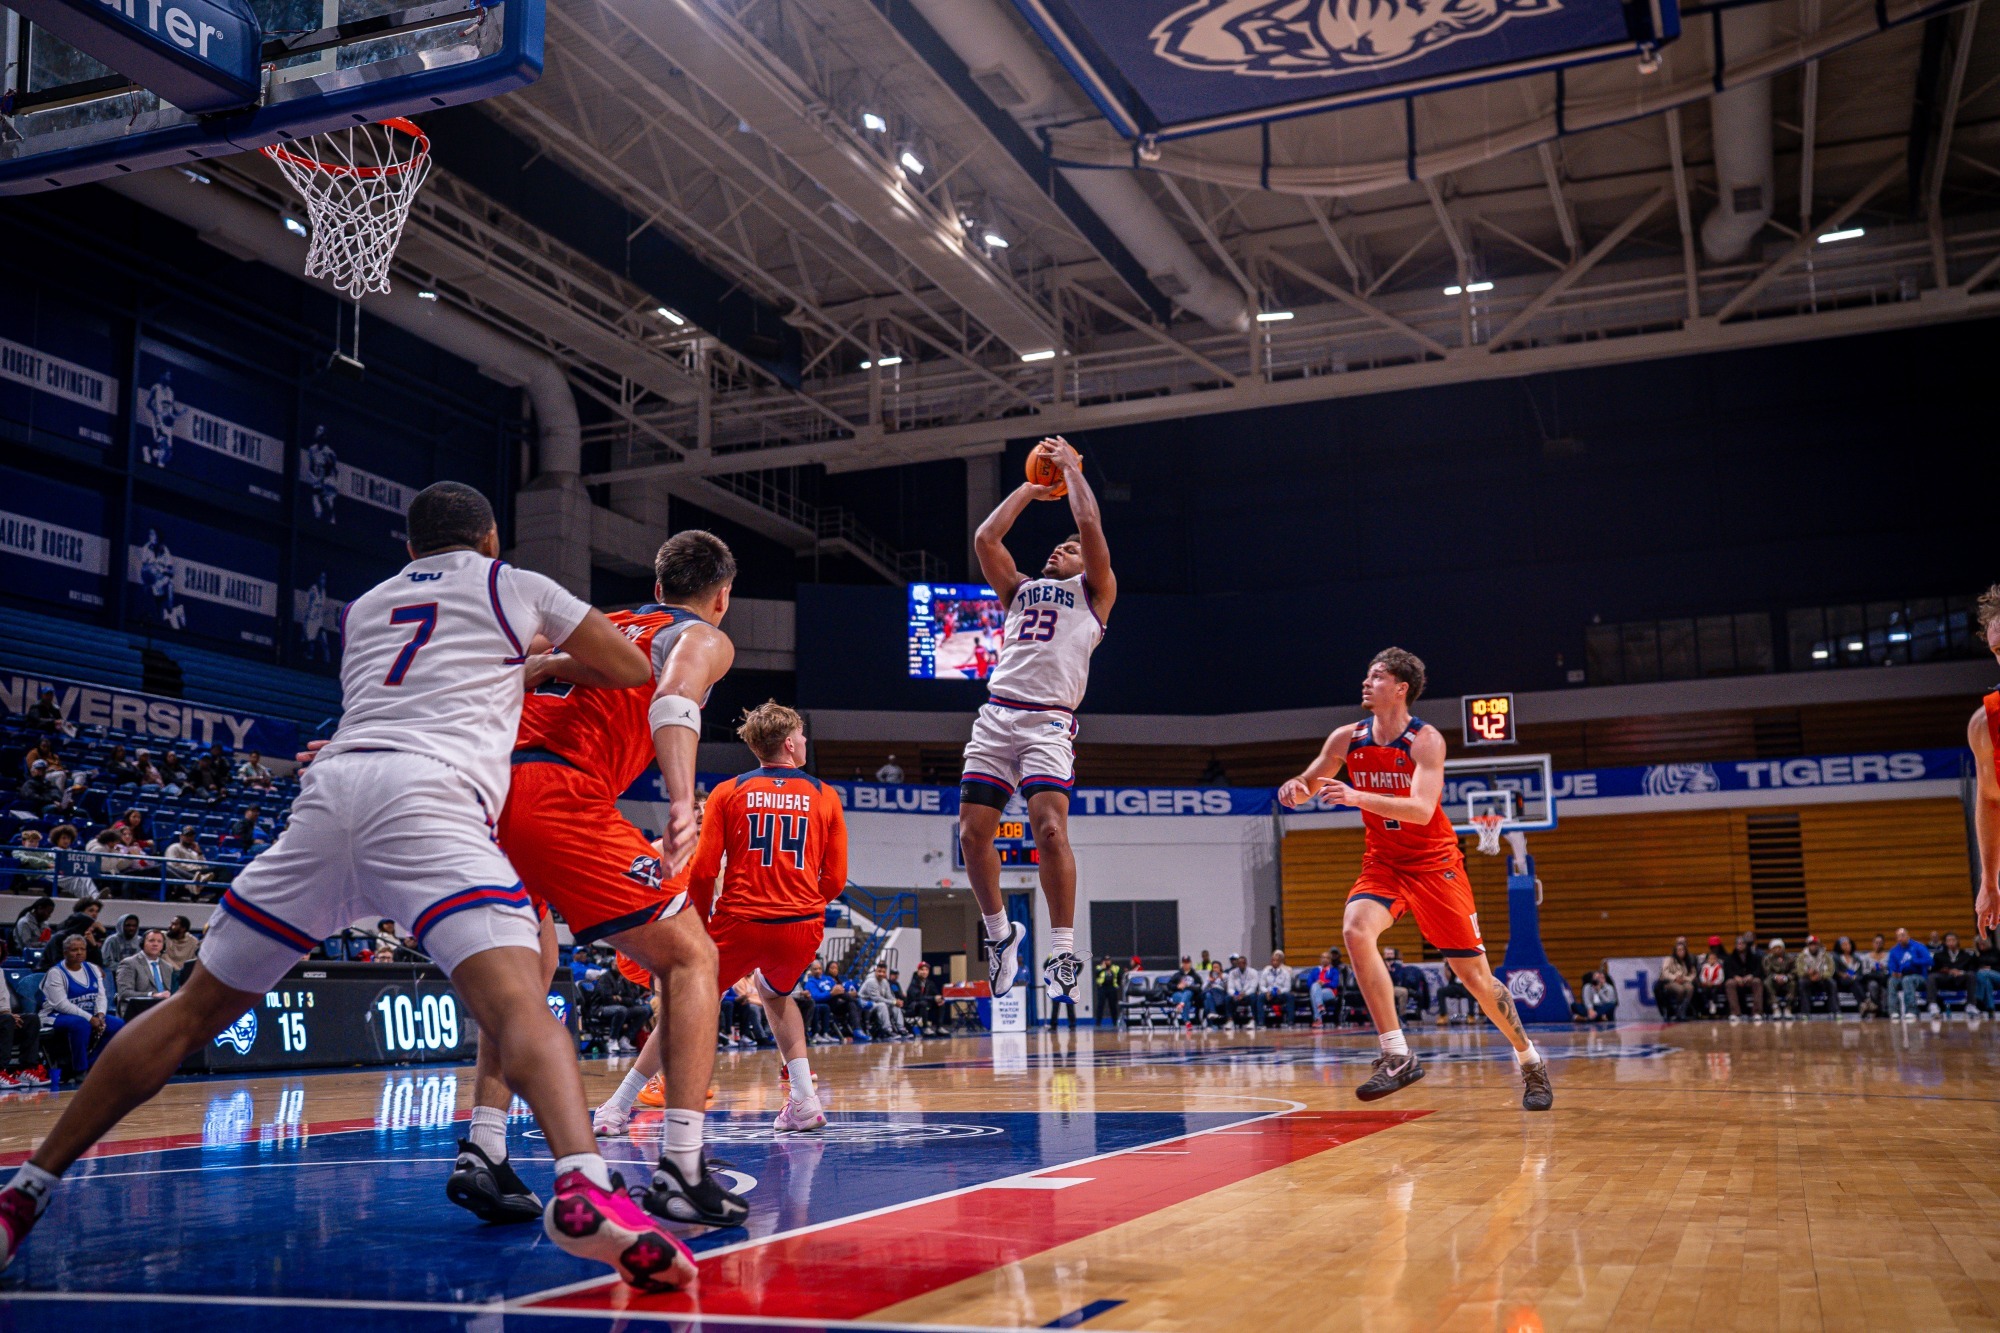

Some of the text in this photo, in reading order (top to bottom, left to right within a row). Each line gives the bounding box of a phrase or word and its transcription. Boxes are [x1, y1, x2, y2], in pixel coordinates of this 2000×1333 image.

[47, 362, 103, 402] COVINGTON
[41, 528, 83, 563] ROGERS
[1017, 585, 1075, 611] TIGERS
[1017, 609, 1058, 642] 23
[383, 602, 438, 686] 7
[1473, 698, 1508, 715] 10:08
[1353, 771, 1412, 789] UT MARTIN
[1736, 753, 1926, 787] TIGERS
[854, 786, 940, 811] BLUE
[1496, 773, 1598, 802] BLUE
[747, 791, 810, 812] DENIUSAS
[1076, 790, 1232, 814] TIGERS
[746, 813, 808, 870] 44
[67, 852, 97, 863] SECTION
[73, 862, 89, 875] P-1
[298, 991, 304, 1008] F
[306, 991, 314, 1008] 3
[278, 1012, 307, 1051] 15
[377, 995, 459, 1050] 10:09
